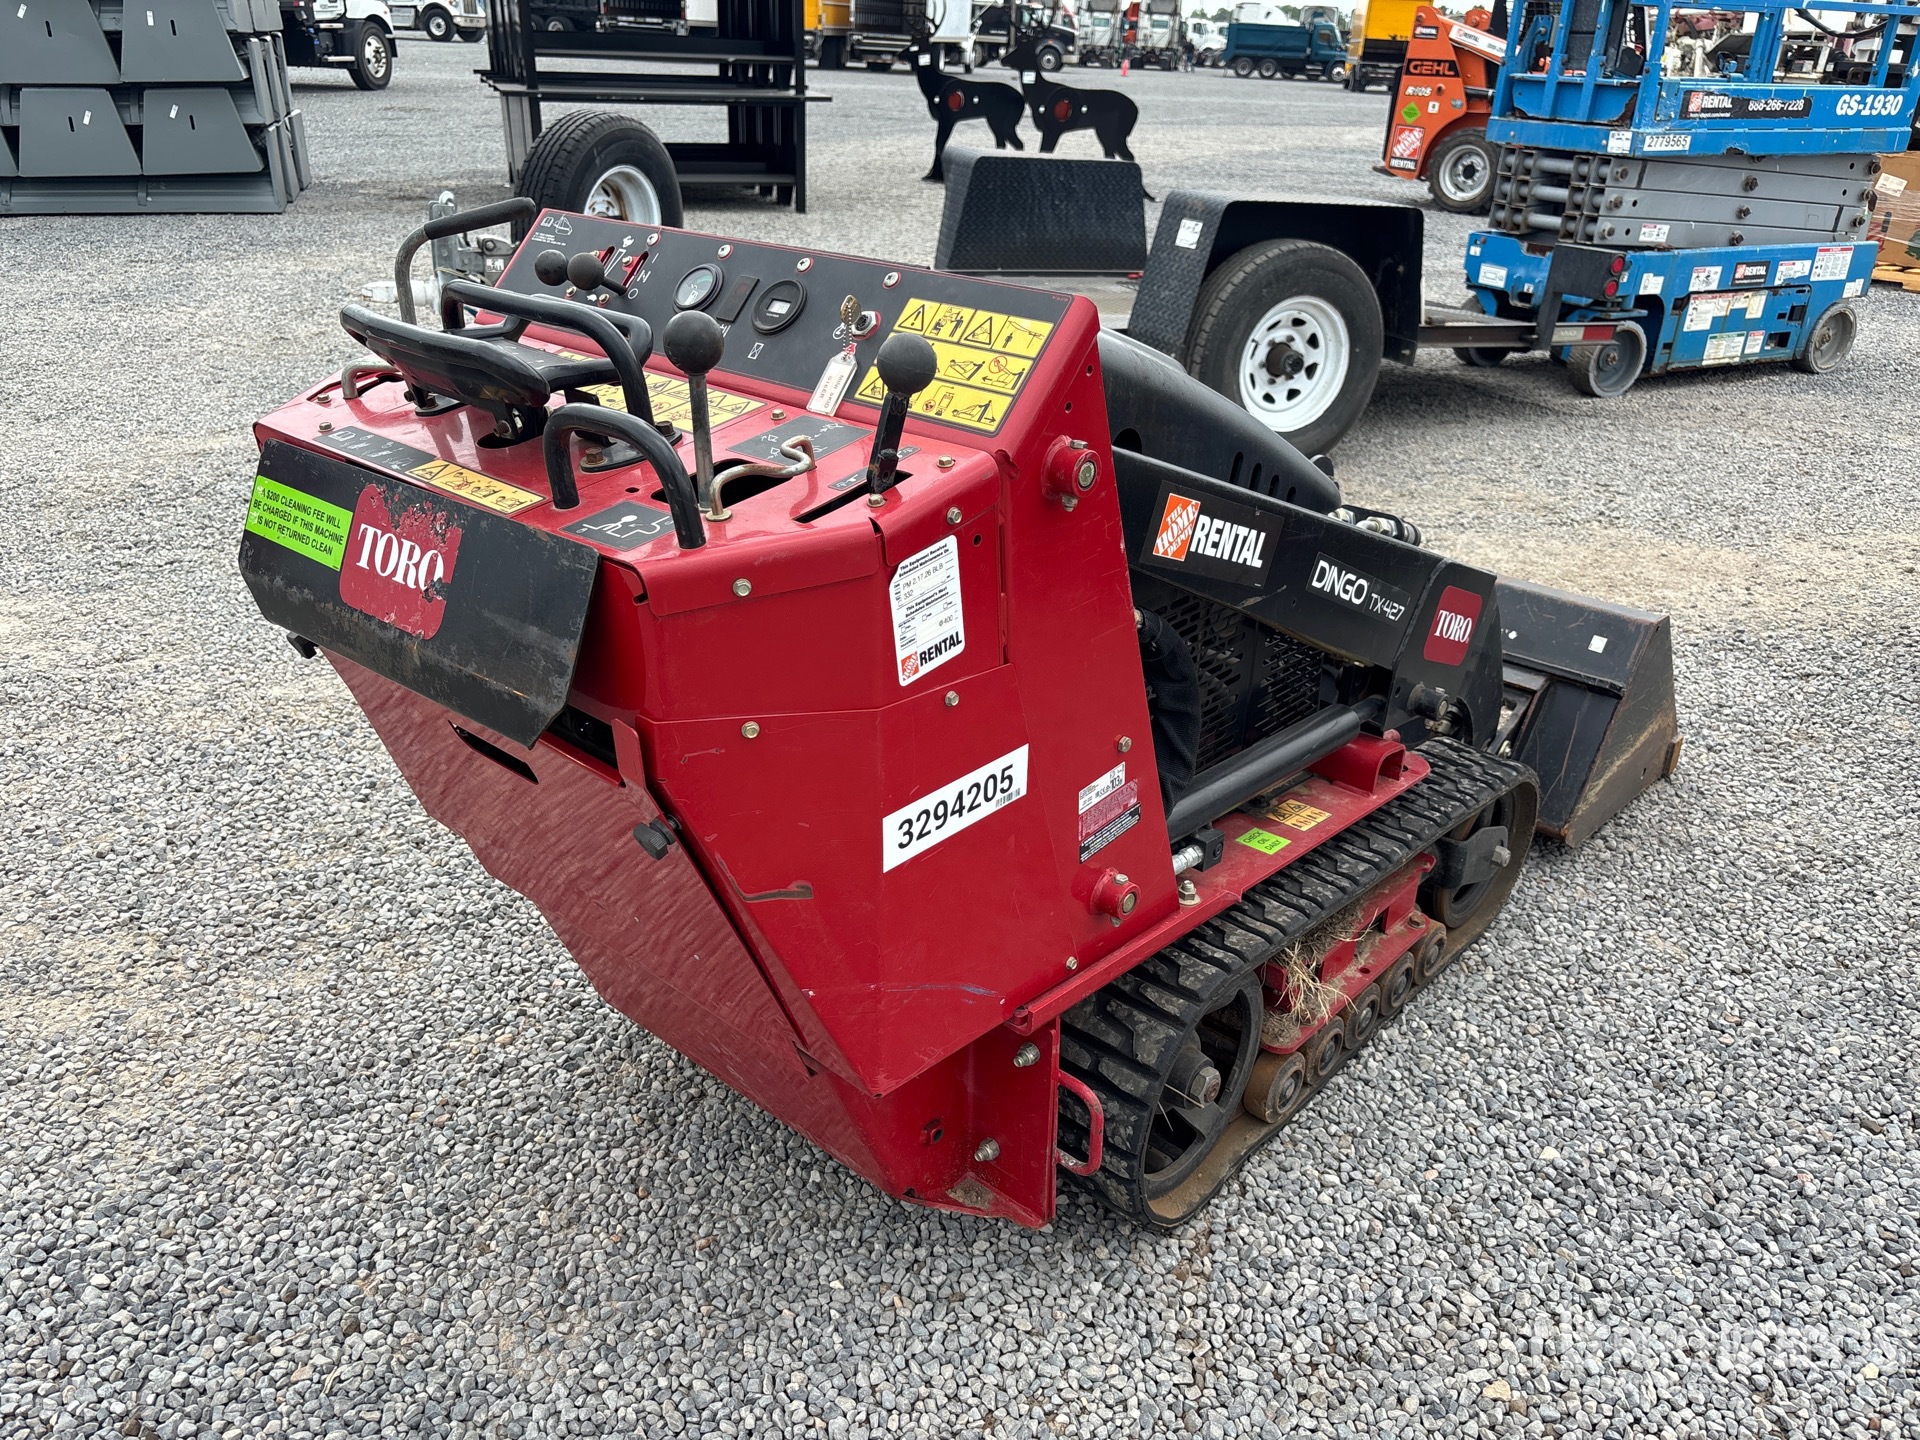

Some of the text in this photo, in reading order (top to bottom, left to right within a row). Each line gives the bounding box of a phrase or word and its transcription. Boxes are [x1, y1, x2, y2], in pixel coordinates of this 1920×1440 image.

[1409, 61, 1455, 75] GEHL
[1702, 95, 1733, 108] RENTAL
[1835, 94, 1903, 116] GS-1930
[1647, 135, 1688, 148] 2779565
[266, 489, 280, 503] $200
[280, 495, 312, 516] CLEANING
[312, 508, 326, 522] FEE
[326, 513, 341, 529] WILL
[1166, 503, 1183, 526] THE
[253, 498, 344, 546] BE CHARGED IF THIS MACHINE
[1156, 500, 1199, 555] HOME
[257, 515, 334, 556] IS NOT RETURNED CLEAN
[1167, 523, 1195, 557] DEPOT
[1189, 514, 1266, 568] RENTAL
[356, 523, 444, 591] TORO
[899, 543, 948, 571] This Equipment Received
[898, 564, 919, 578] Scheduled
[1311, 560, 1368, 605] DINGO
[902, 580, 912, 590] PM
[903, 589, 914, 600] 332
[905, 604, 915, 612] This
[905, 604, 925, 618] Scheduled
[1434, 609, 1472, 643] TORO
[919, 630, 963, 667] RENTAL
[897, 764, 1014, 849] 3294205
[1243, 831, 1263, 843] CHECK
[1264, 839, 1282, 850] DAILY
